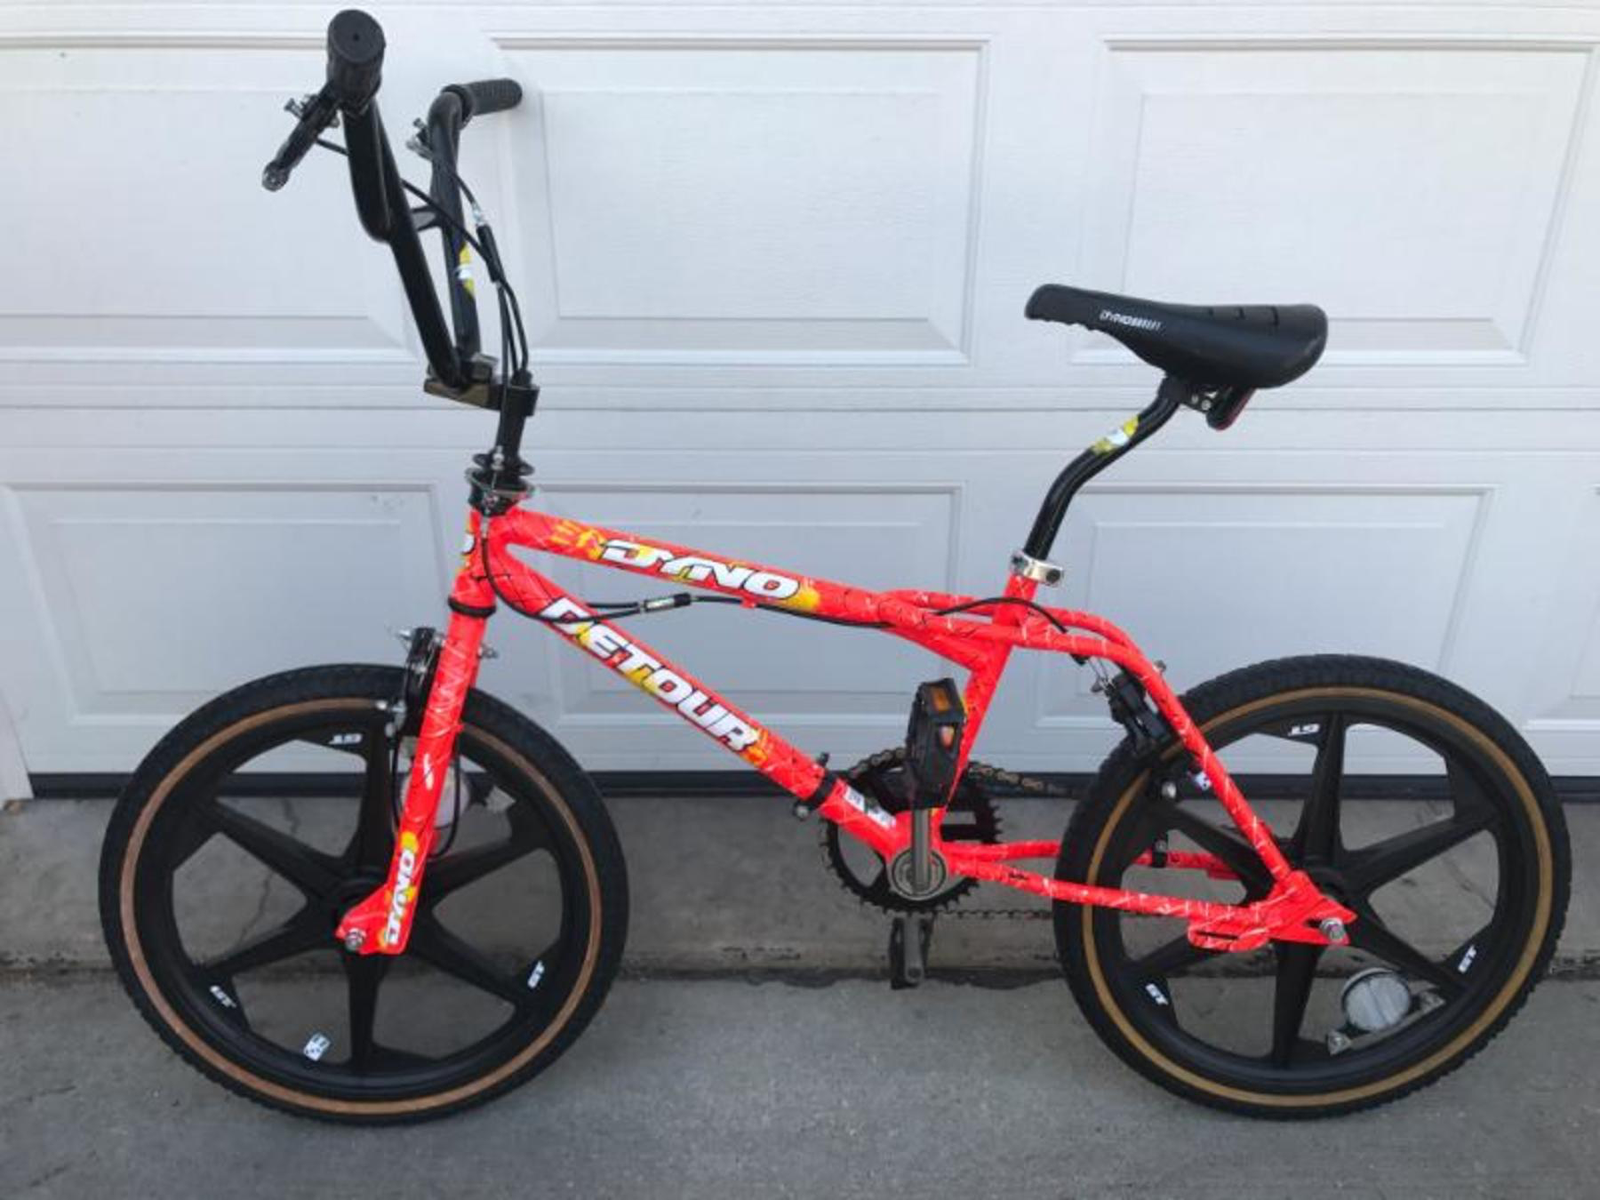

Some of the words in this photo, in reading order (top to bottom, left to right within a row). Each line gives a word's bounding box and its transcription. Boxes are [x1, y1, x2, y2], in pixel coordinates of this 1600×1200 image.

[540, 597, 758, 751] DETOUR
[1287, 723, 1320, 737] GT
[386, 849, 415, 945] DYNO
